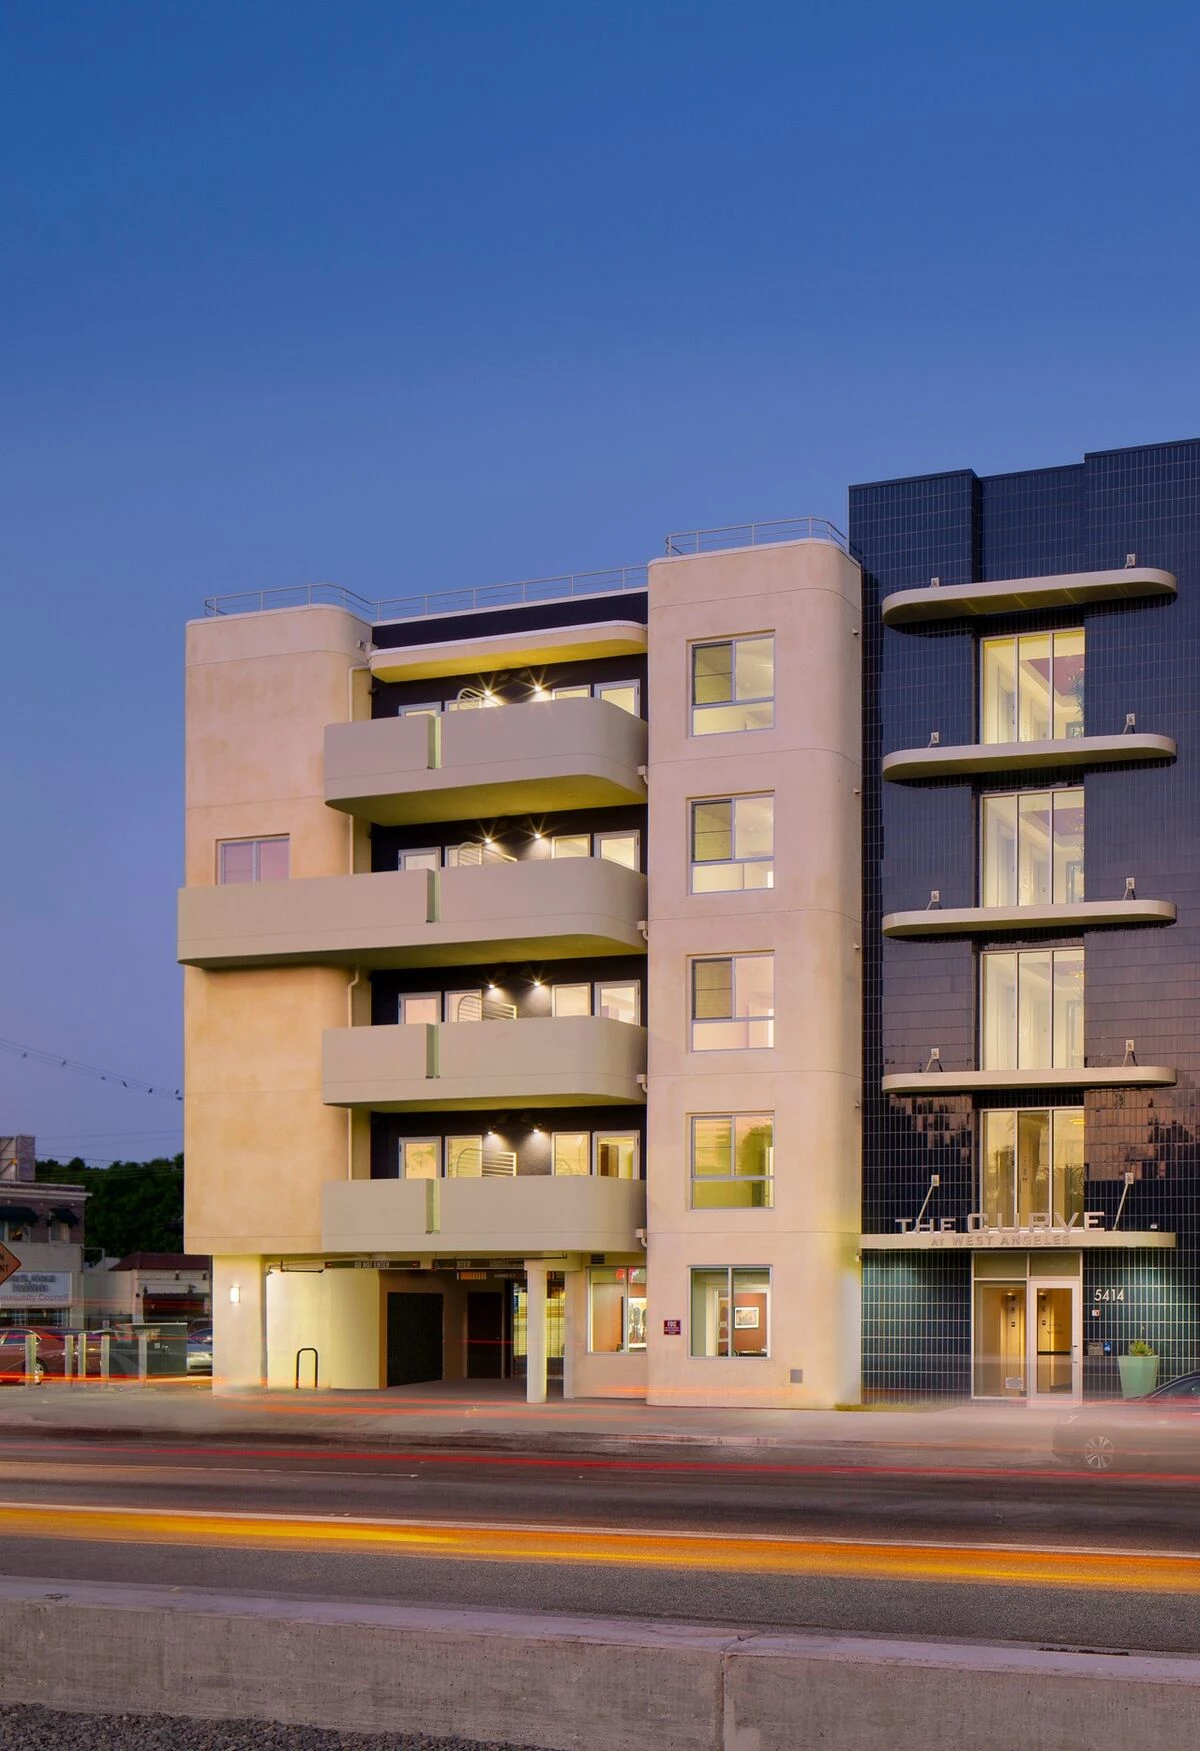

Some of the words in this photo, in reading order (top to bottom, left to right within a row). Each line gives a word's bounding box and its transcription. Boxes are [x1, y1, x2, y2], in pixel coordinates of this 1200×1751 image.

[895, 1218, 956, 1233] THE
[967, 1211, 1105, 1233] CURVE
[931, 1238, 944, 1247] AT
[952, 1235, 994, 1246] WEST
[1000, 1235, 1071, 1246] ANGELES
[1094, 1289, 1124, 1301] 5414
